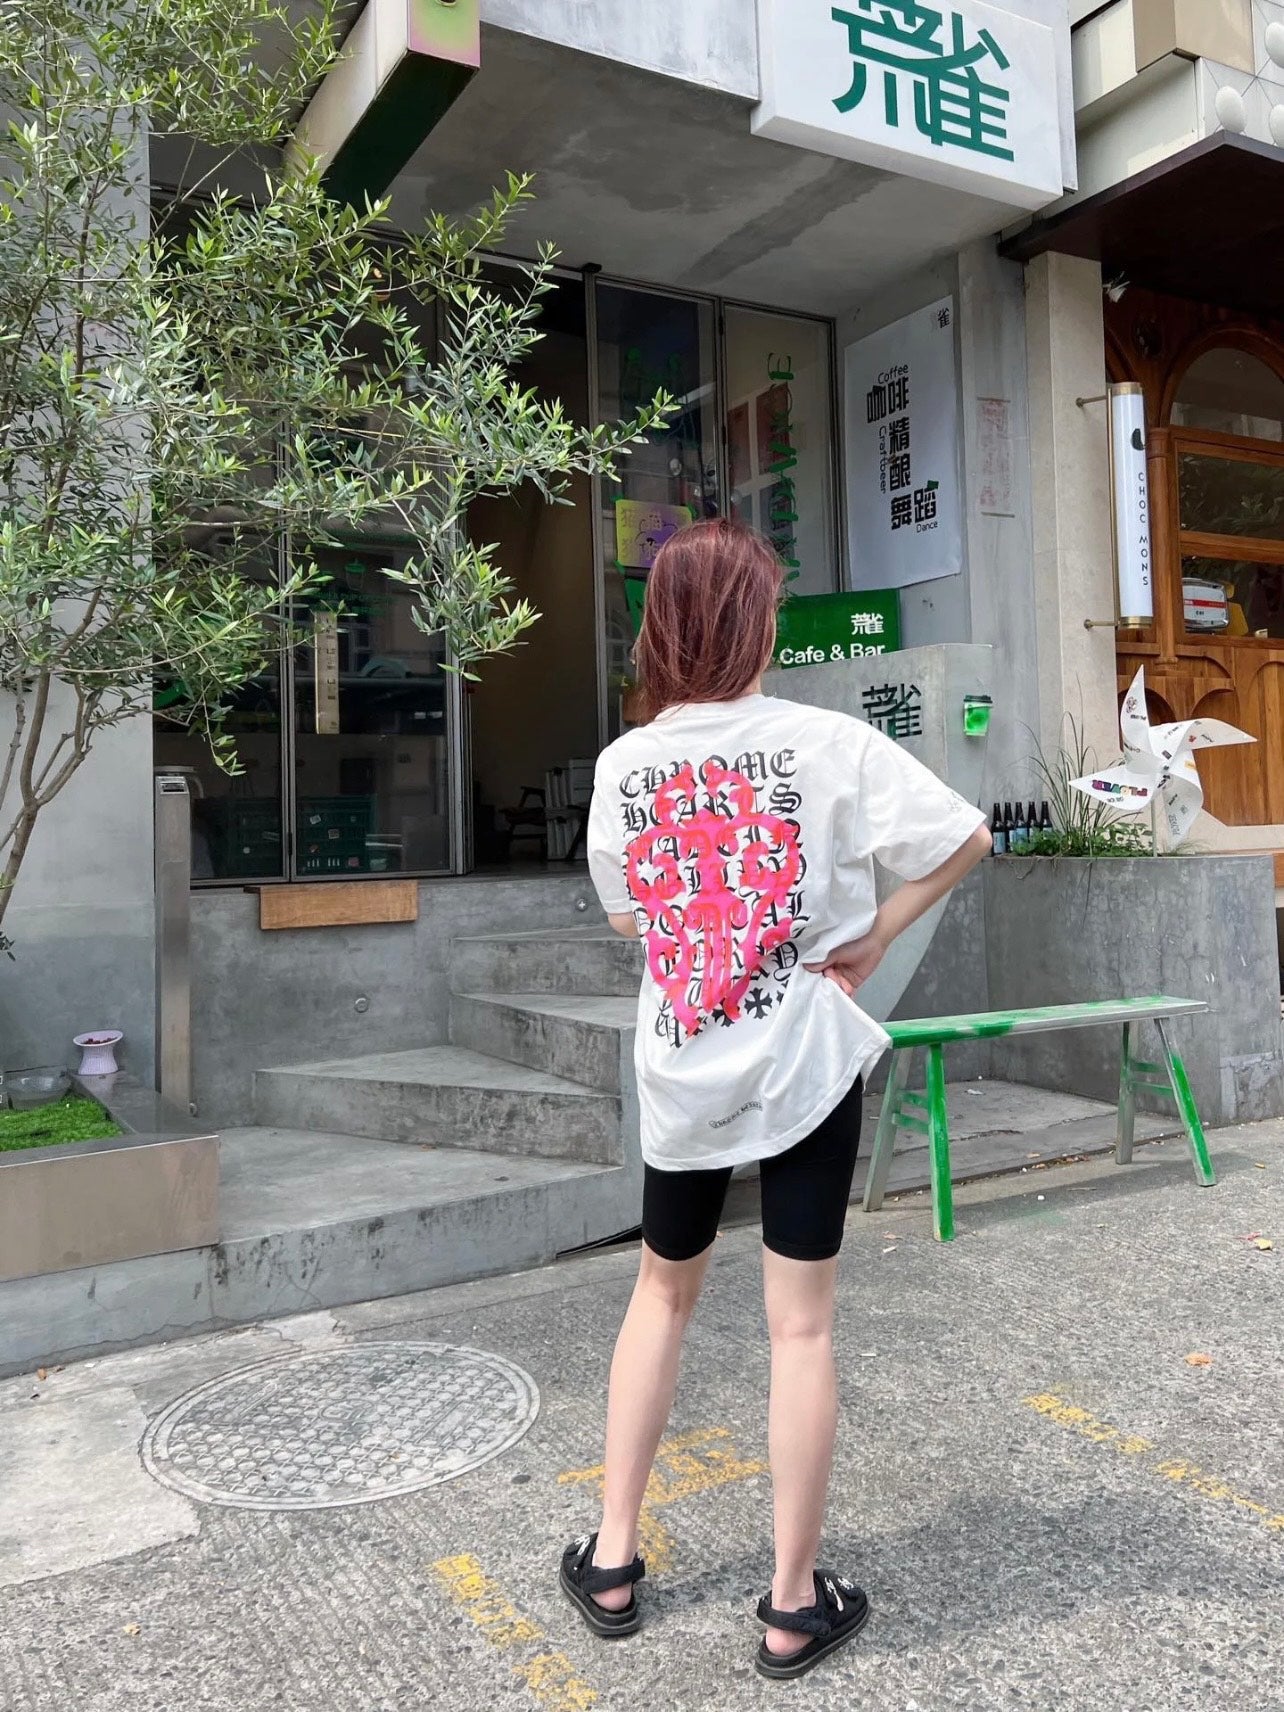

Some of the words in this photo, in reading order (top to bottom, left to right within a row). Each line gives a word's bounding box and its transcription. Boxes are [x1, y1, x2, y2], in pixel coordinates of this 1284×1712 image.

[877, 363, 909, 385] Coffee
[866, 376, 910, 423] 咖啡
[888, 416, 911, 492] 精酿
[890, 480, 939, 530] 舞蹈
[1138, 472, 1147, 523] CHOC
[916, 520, 938, 534] Dance
[1139, 536, 1149, 586] MONS
[779, 645, 825, 665] Cafe
[829, 643, 846, 661] &
[850, 642, 886, 658] Bar
